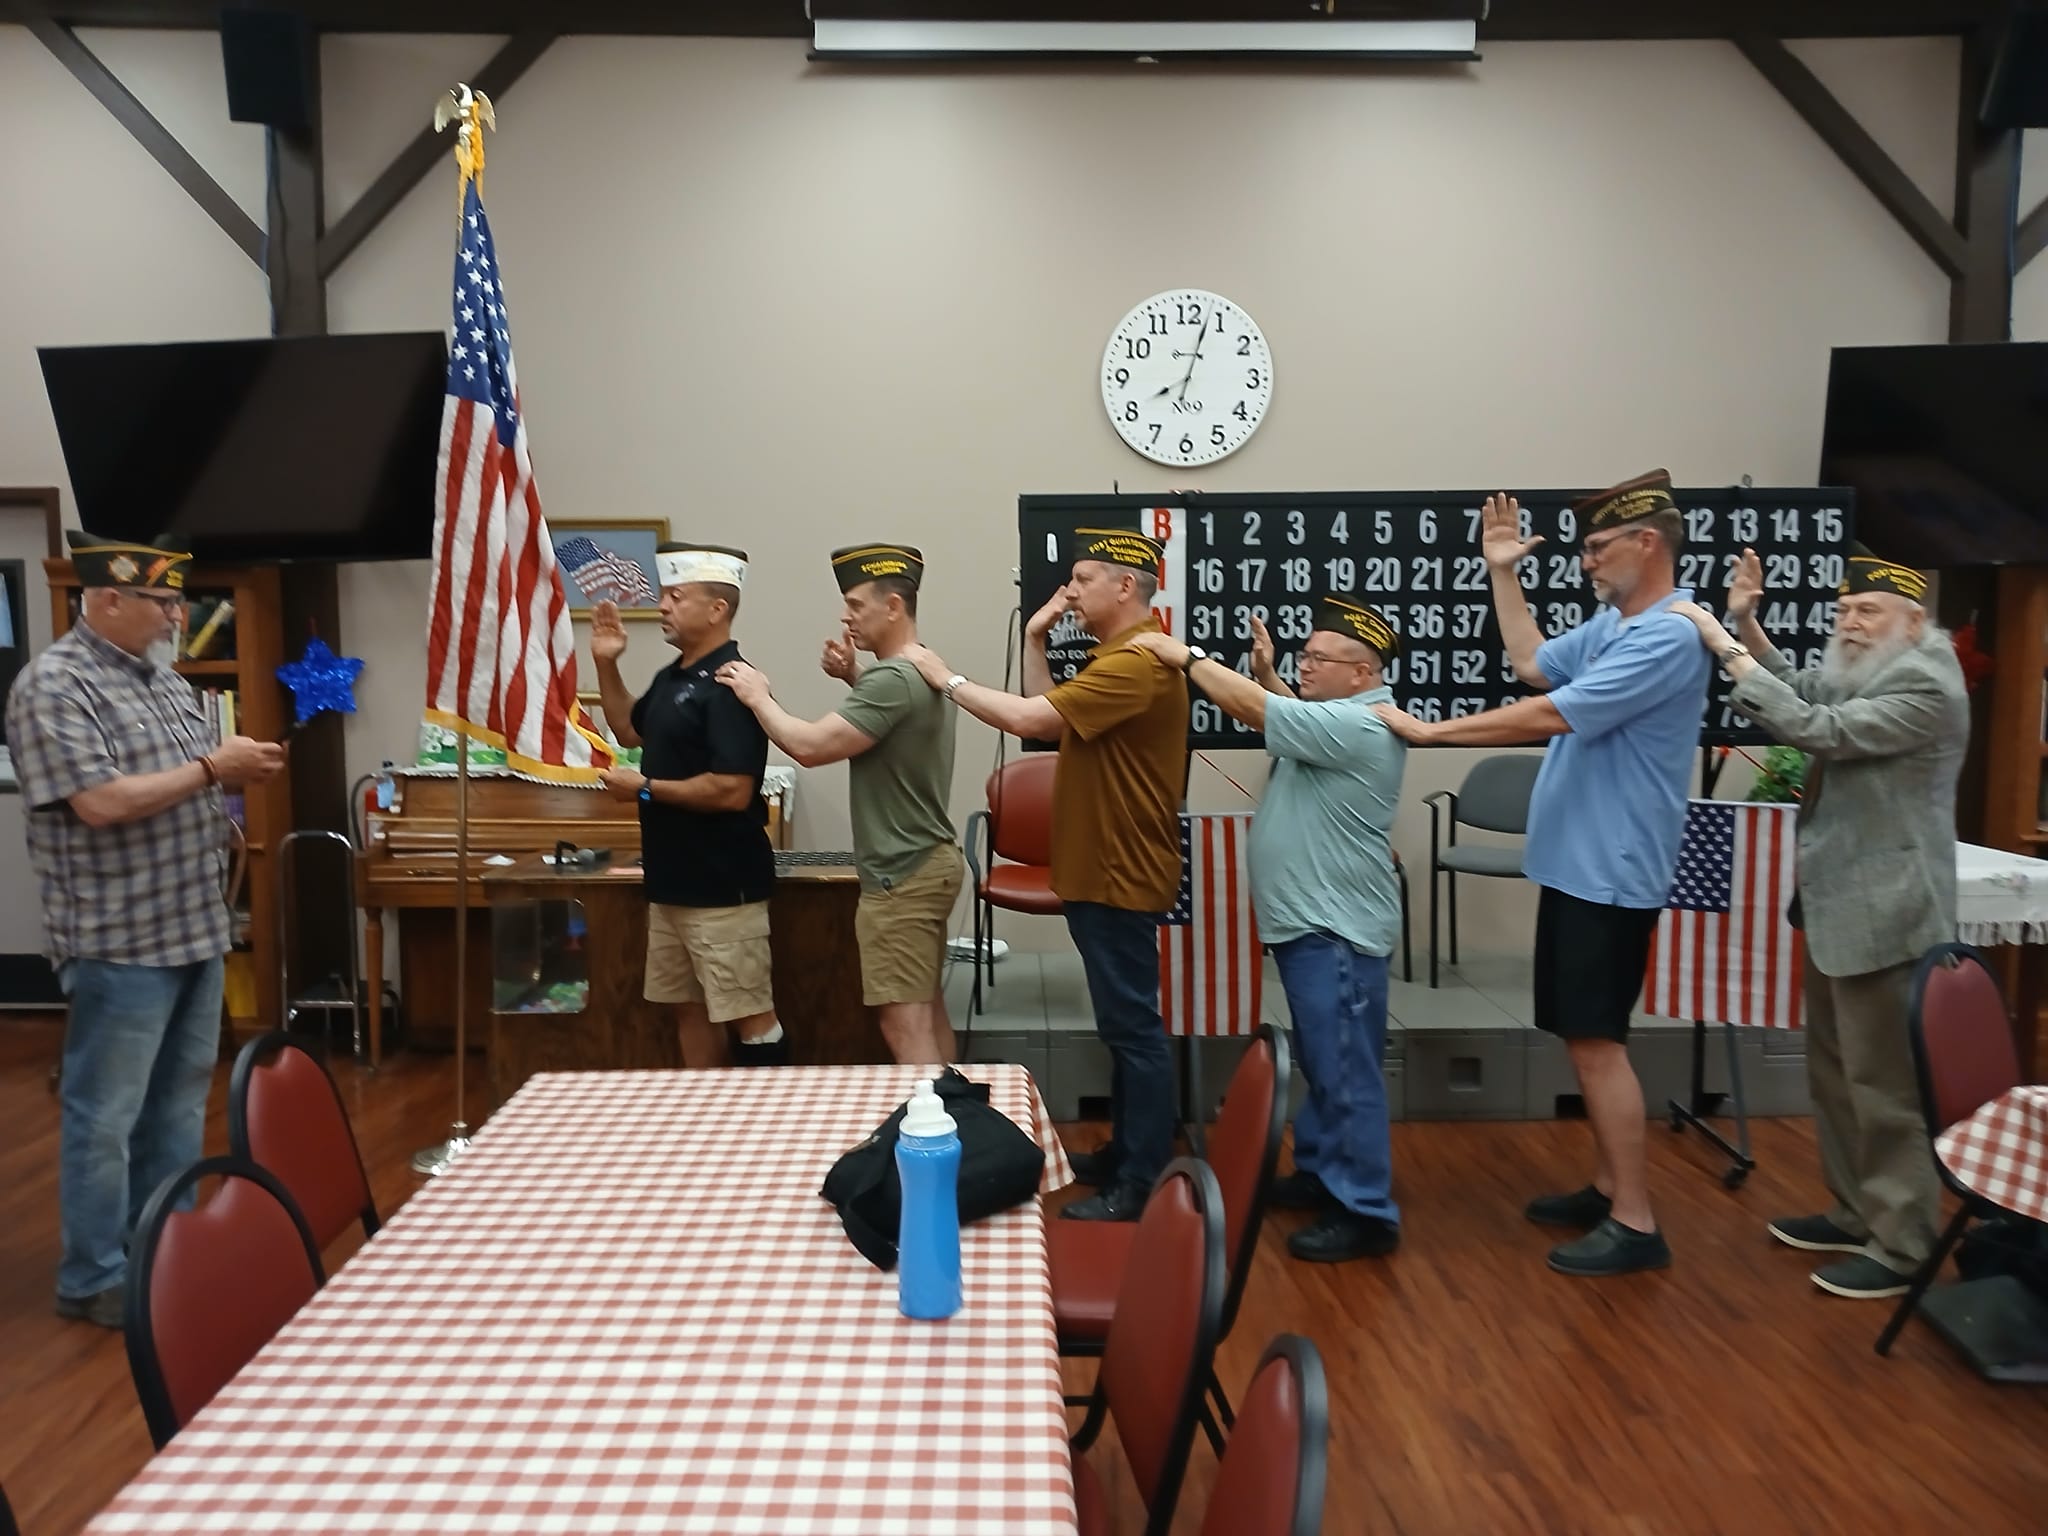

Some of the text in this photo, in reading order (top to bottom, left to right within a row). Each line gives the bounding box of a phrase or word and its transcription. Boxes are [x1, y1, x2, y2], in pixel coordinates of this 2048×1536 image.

[1149, 314, 1168, 335] 11
[1176, 304, 1202, 325] 12
[1215, 312, 1224, 332] 1
[1126, 338, 1151, 359] 10
[1237, 335, 1250, 356] 2
[1115, 368, 1130, 389] 9
[1246, 368, 1260, 389] 3
[1125, 401, 1139, 422] 8
[1232, 400, 1247, 421] 4
[1149, 424, 1162, 444] 7
[1179, 433, 1193, 453] 6
[1210, 425, 1225, 445] 5
[1154, 508, 1172, 541] B
[1200, 511, 1214, 546] 1
[1243, 511, 1261, 545] 2
[1287, 510, 1305, 545] 3
[1330, 511, 1349, 544] 4
[1374, 511, 1393, 544] 5
[1419, 509, 1437, 544] 6
[1464, 509, 1481, 543] 7
[1558, 509, 1577, 543] 9
[1683, 508, 1715, 542] 12
[1727, 508, 1759, 543] 13
[1769, 508, 1800, 542] 14
[1812, 508, 1843, 542] 15
[1192, 558, 1224, 593] 16
[1236, 558, 1267, 592] 17
[1280, 558, 1311, 592] 18
[1324, 557, 1355, 592] 19
[1365, 557, 1401, 591] 20
[1411, 557, 1443, 590] 21
[1453, 557, 1488, 590] 22
[1514, 555, 1540, 589] 3
[1548, 555, 1583, 588] 24
[1679, 554, 1715, 588] 27
[1722, 554, 1740, 588] 2
[1765, 554, 1801, 588] 29
[1808, 554, 1843, 588] 30
[1192, 605, 1224, 639] 31
[1277, 605, 1313, 639] 33
[1408, 604, 1444, 638] 36
[1452, 604, 1488, 638] 37
[1546, 602, 1583, 636] 39
[1763, 602, 1799, 634] 44
[1805, 602, 1837, 634] 45
[1409, 651, 1441, 684] 51
[1452, 650, 1486, 684] 52
[1192, 699, 1222, 733] 61
